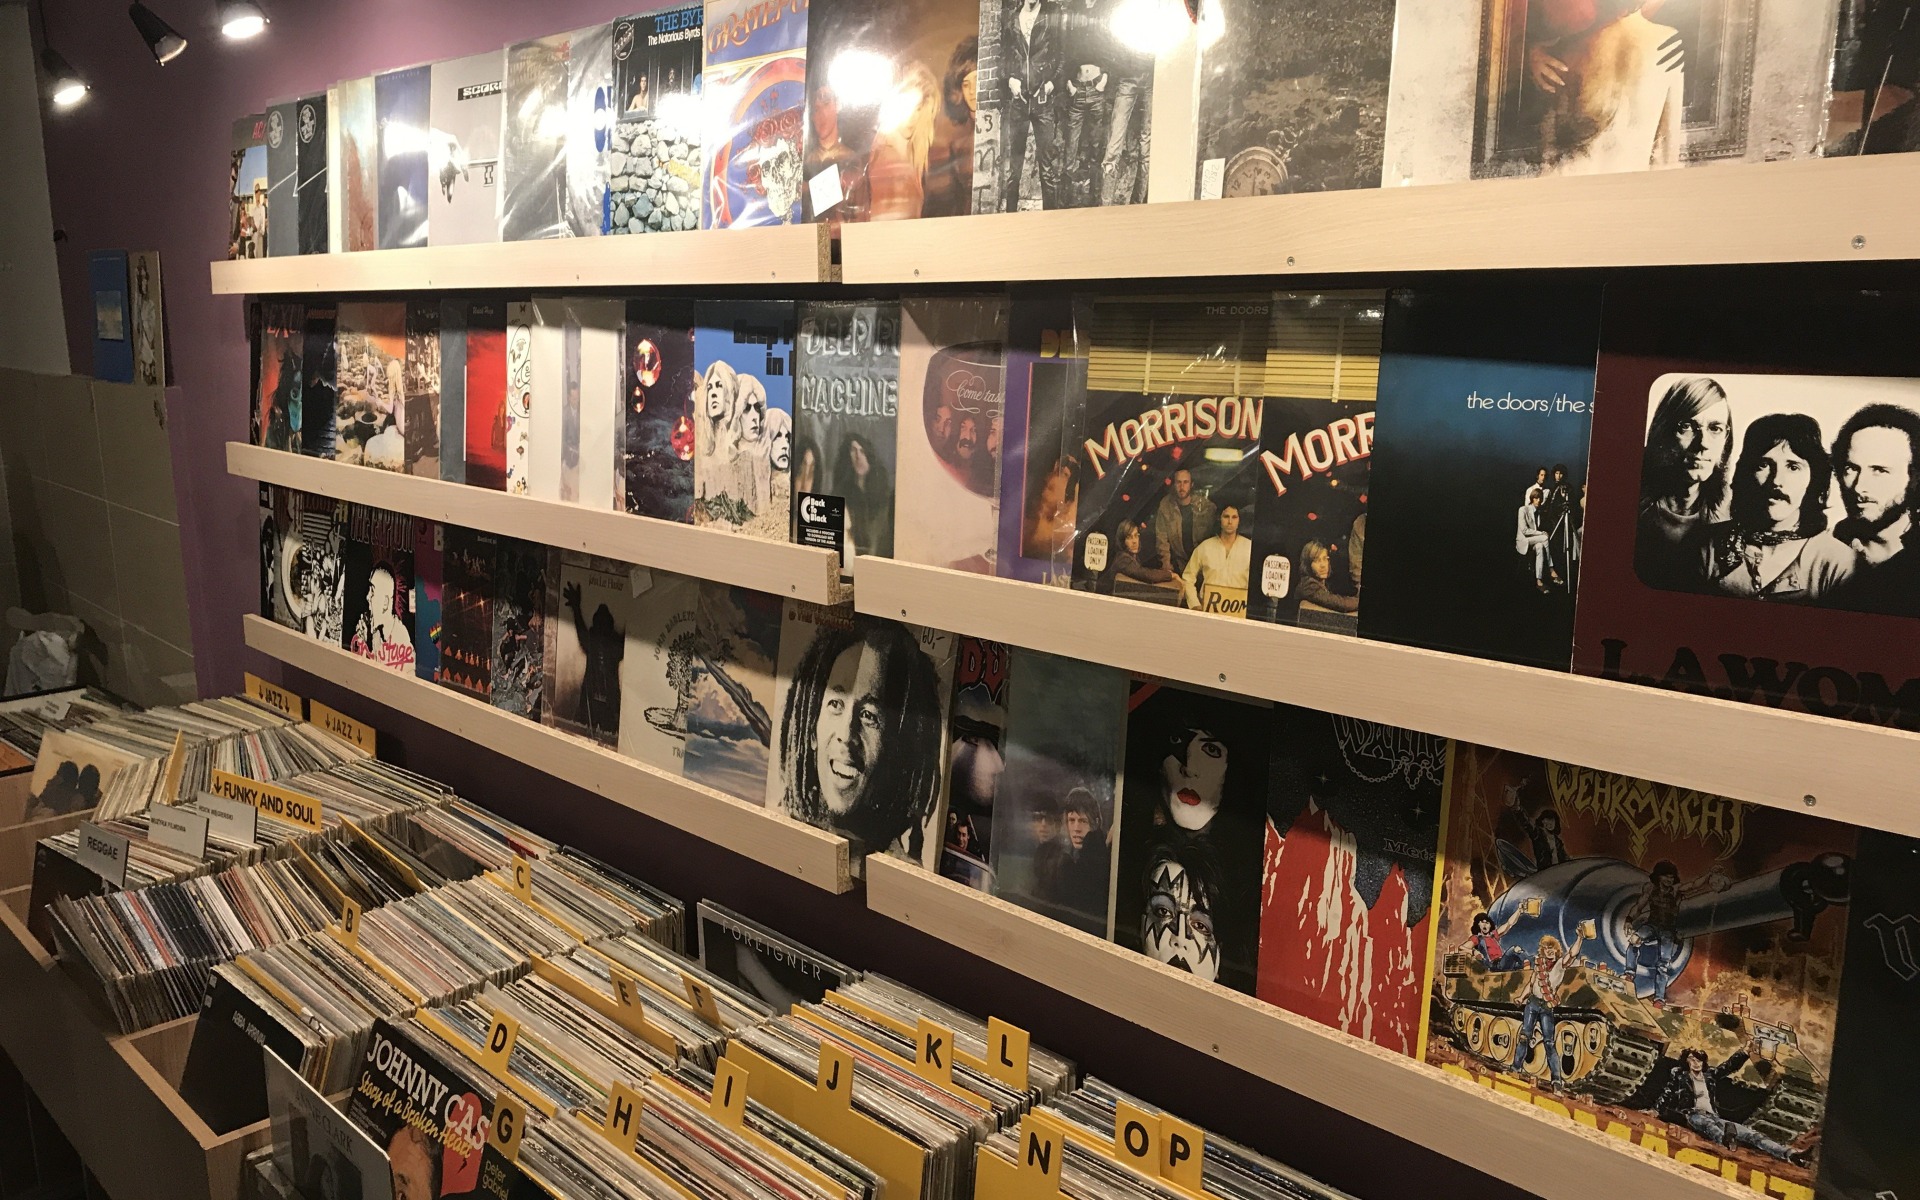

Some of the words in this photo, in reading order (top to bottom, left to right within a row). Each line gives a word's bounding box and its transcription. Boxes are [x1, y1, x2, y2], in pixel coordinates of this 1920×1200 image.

[648, 35, 658, 46] The
[658, 31, 684, 45] Notorious
[684, 27, 701, 41] Byrds
[655, 14, 679, 33] THE
[1205, 305, 1226, 315] THE
[1230, 305, 1269, 316] DOORS
[801, 375, 899, 417] MACHINE
[1466, 391, 1494, 410] the
[1084, 396, 1264, 480] MORRISON
[810, 498, 826, 508] Back
[810, 513, 828, 524] Black
[1265, 560, 1289, 571] PASSENGER
[1265, 571, 1286, 581] LOADING
[1267, 581, 1281, 591] ONLY
[653, 631, 668, 661] JOHN
[265, 688, 284, 710] JAZZ
[332, 717, 352, 740] JAZZ
[223, 781, 258, 806] FUNKY
[260, 792, 283, 814] AND
[286, 800, 316, 826] SOUL
[87, 836, 119, 860] REGGAE
[516, 865, 525, 890] C
[345, 908, 353, 933] B
[722, 919, 821, 981] FOREIGNER
[618, 981, 632, 1007] E
[692, 985, 704, 1009] F
[491, 1023, 508, 1053] D
[1001, 1033, 1014, 1068] L
[925, 1037, 945, 1069] K
[366, 1032, 449, 1116] JOHNNY
[826, 1060, 840, 1091] J
[723, 1075, 733, 1108] I
[358, 1070, 383, 1108] Story
[382, 1088, 397, 1116] of
[393, 1098, 402, 1115] a
[401, 1096, 439, 1138] Broken
[438, 1124, 471, 1159] Heart
[496, 1108, 514, 1144] G
[612, 1096, 632, 1136] H
[1124, 1120, 1149, 1158] O
[1169, 1132, 1191, 1167] P
[1027, 1131, 1052, 1175] N
[484, 1160, 507, 1182] peter
[482, 1175, 510, 1200] gabriel
